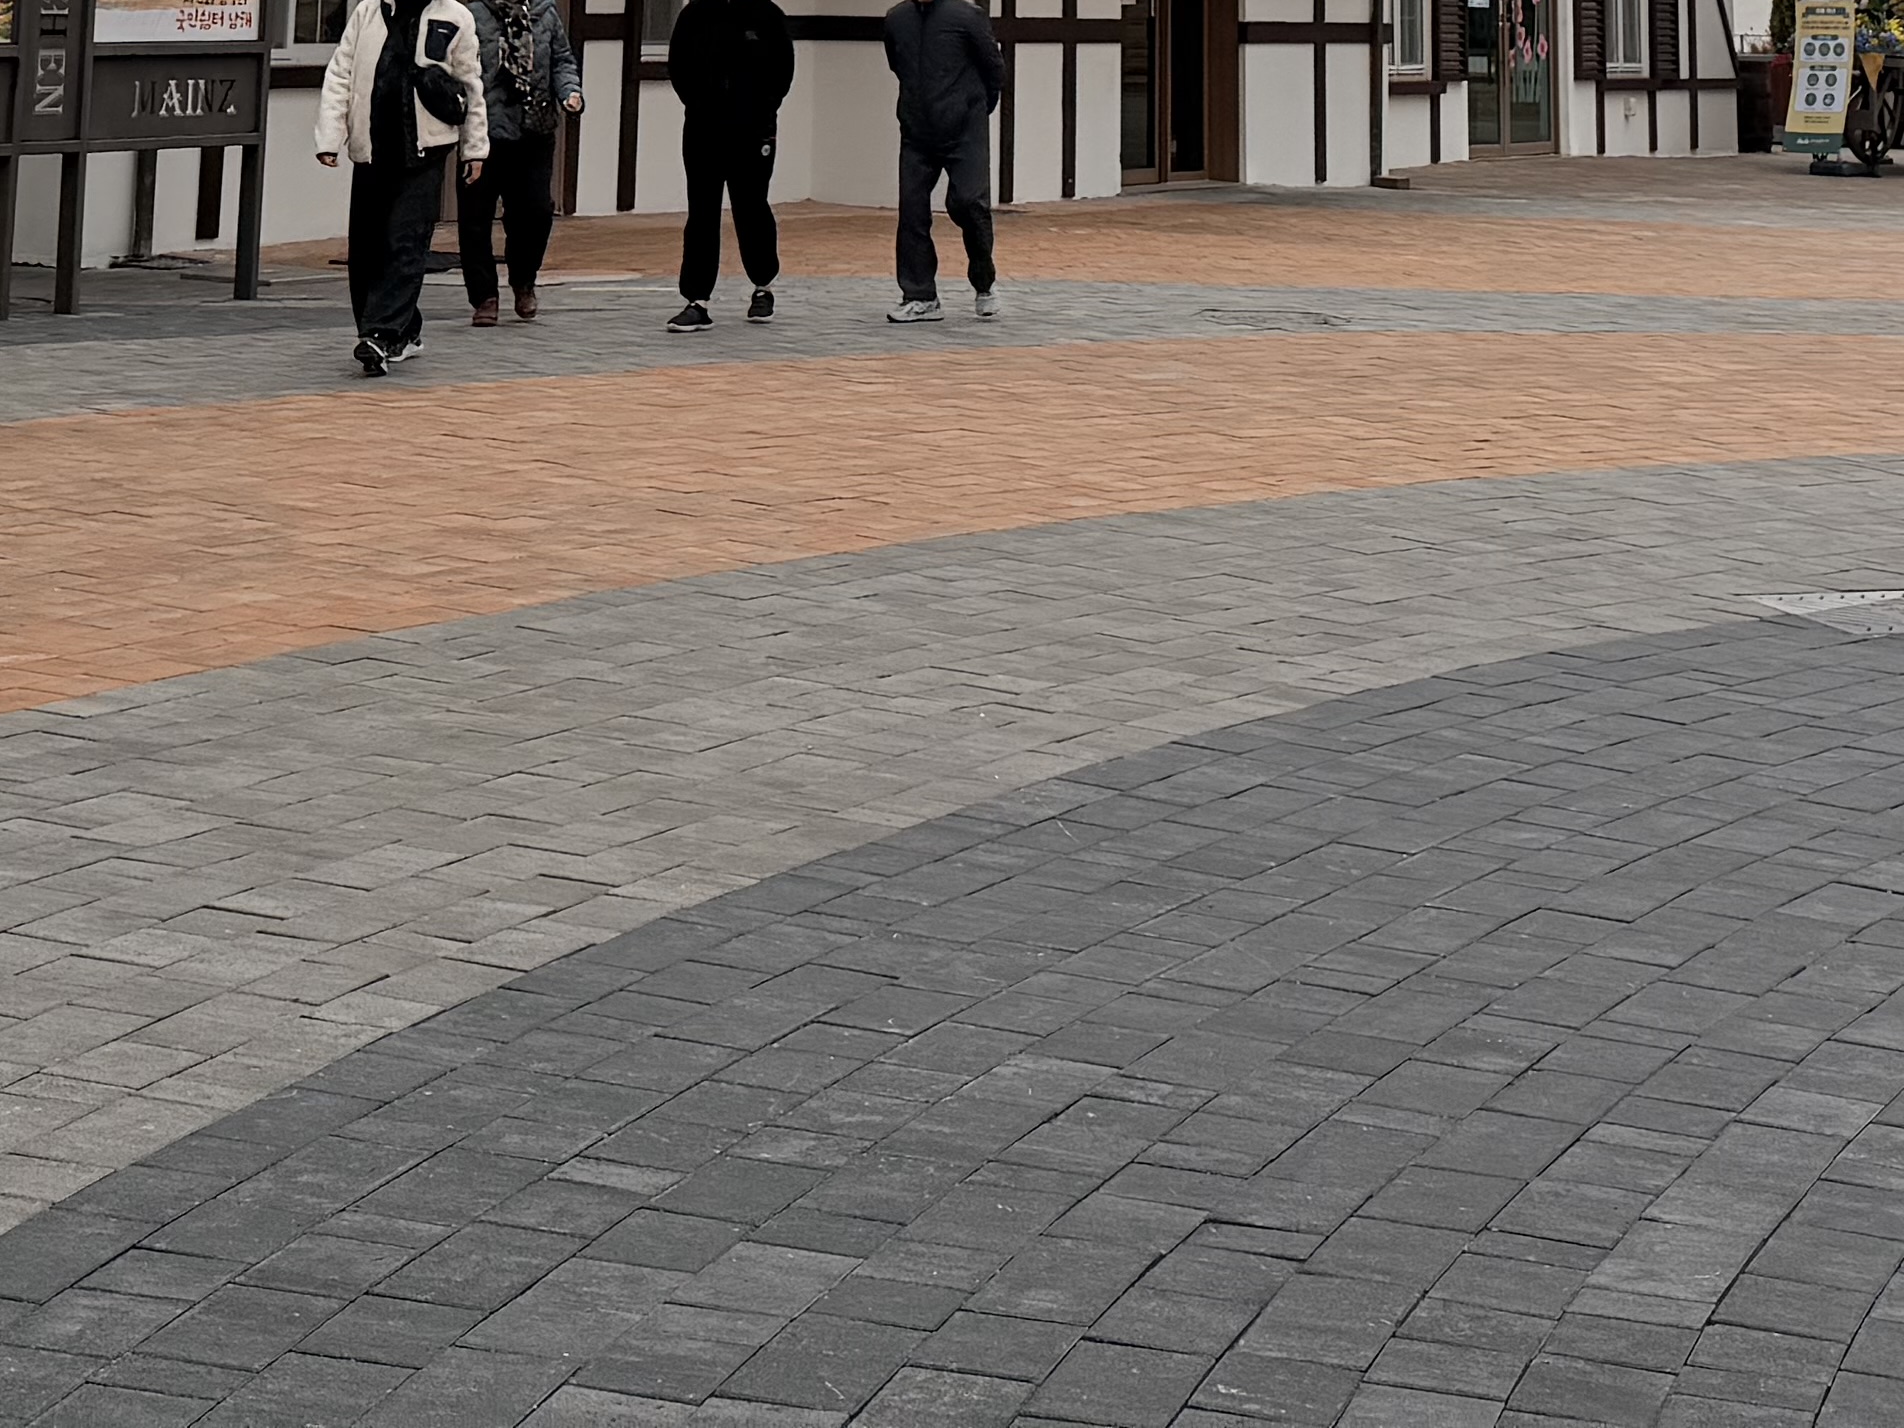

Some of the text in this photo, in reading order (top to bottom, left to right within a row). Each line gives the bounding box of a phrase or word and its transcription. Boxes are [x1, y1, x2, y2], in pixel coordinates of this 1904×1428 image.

[176, 7, 252, 32] 국민쉼터 남해
[131, 79, 237, 118] MAINZ
